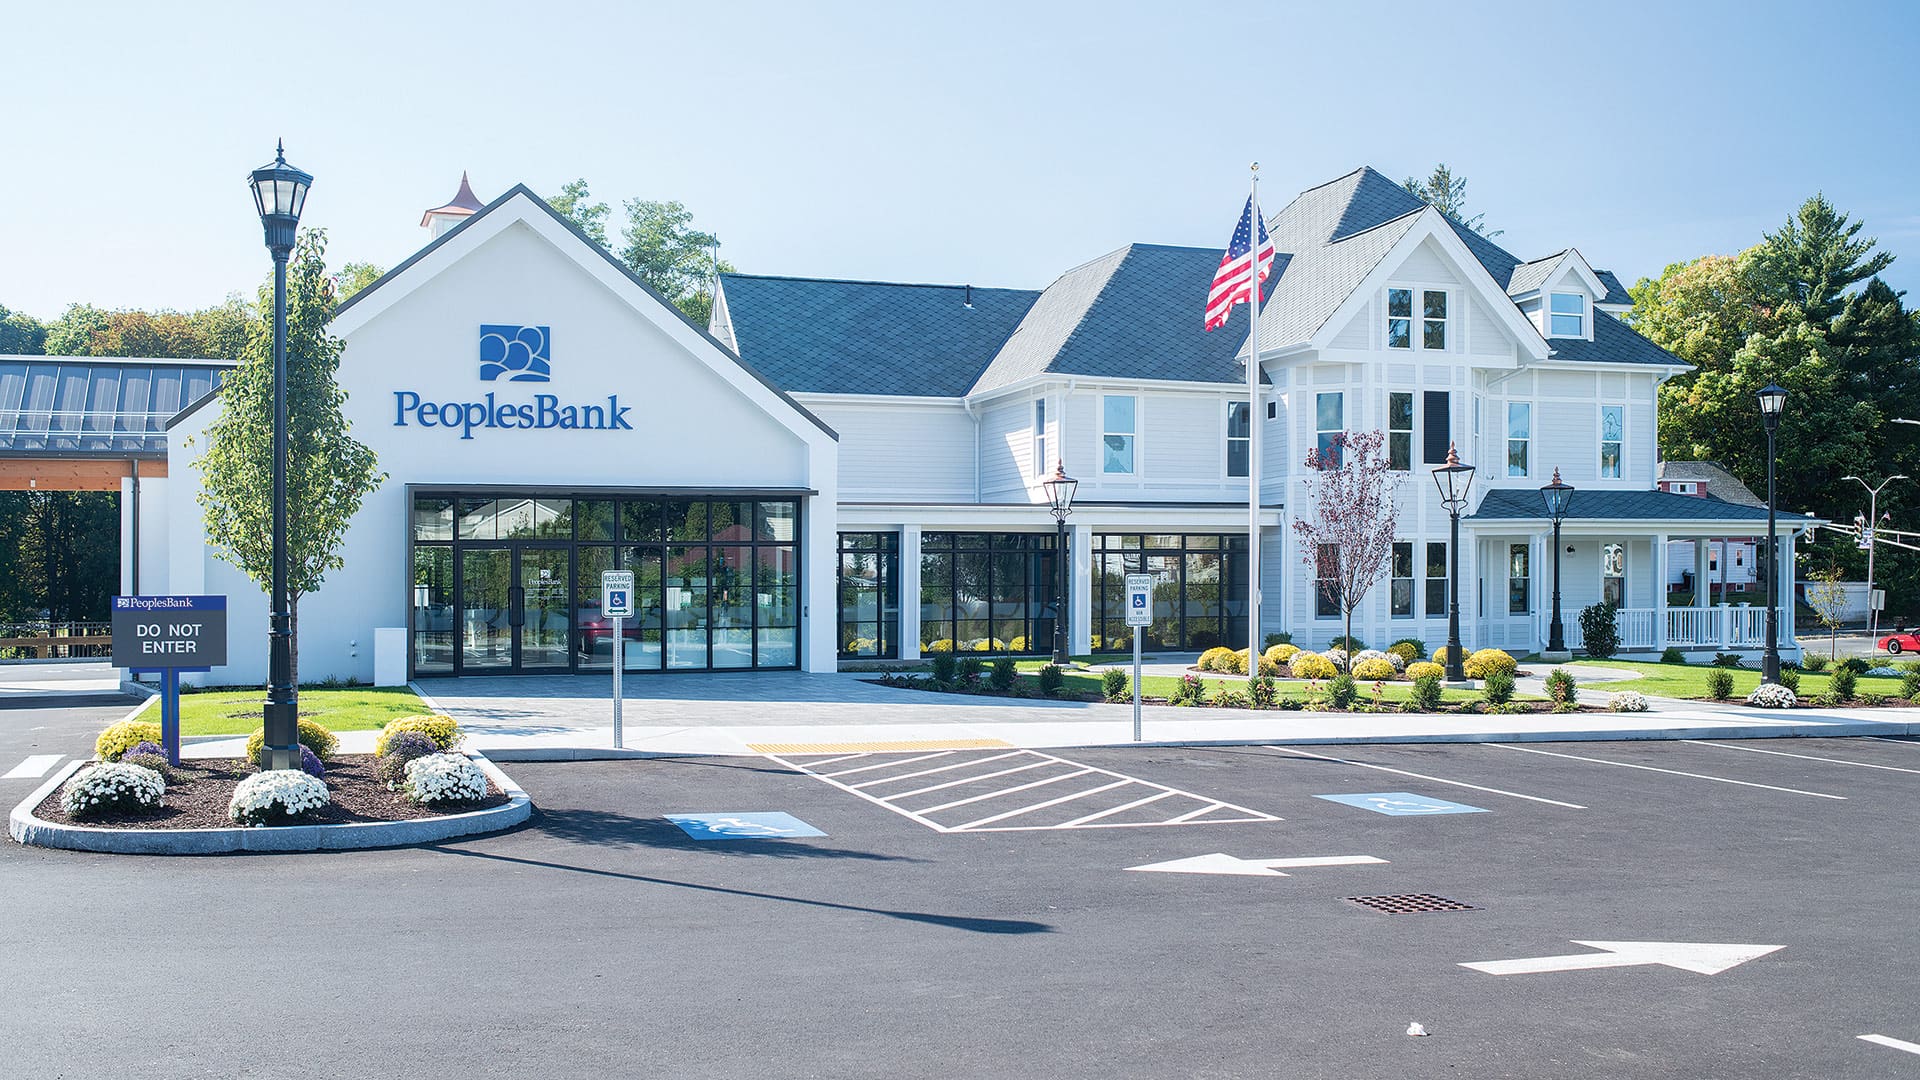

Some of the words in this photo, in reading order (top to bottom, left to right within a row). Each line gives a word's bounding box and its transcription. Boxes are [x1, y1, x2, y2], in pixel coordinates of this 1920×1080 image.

[393, 391, 633, 440] PeoplesBank
[130, 598, 193, 610] PeoplesBank
[137, 624, 161, 637] DO
[169, 624, 202, 636] NOT
[143, 641, 197, 653] ENTER
